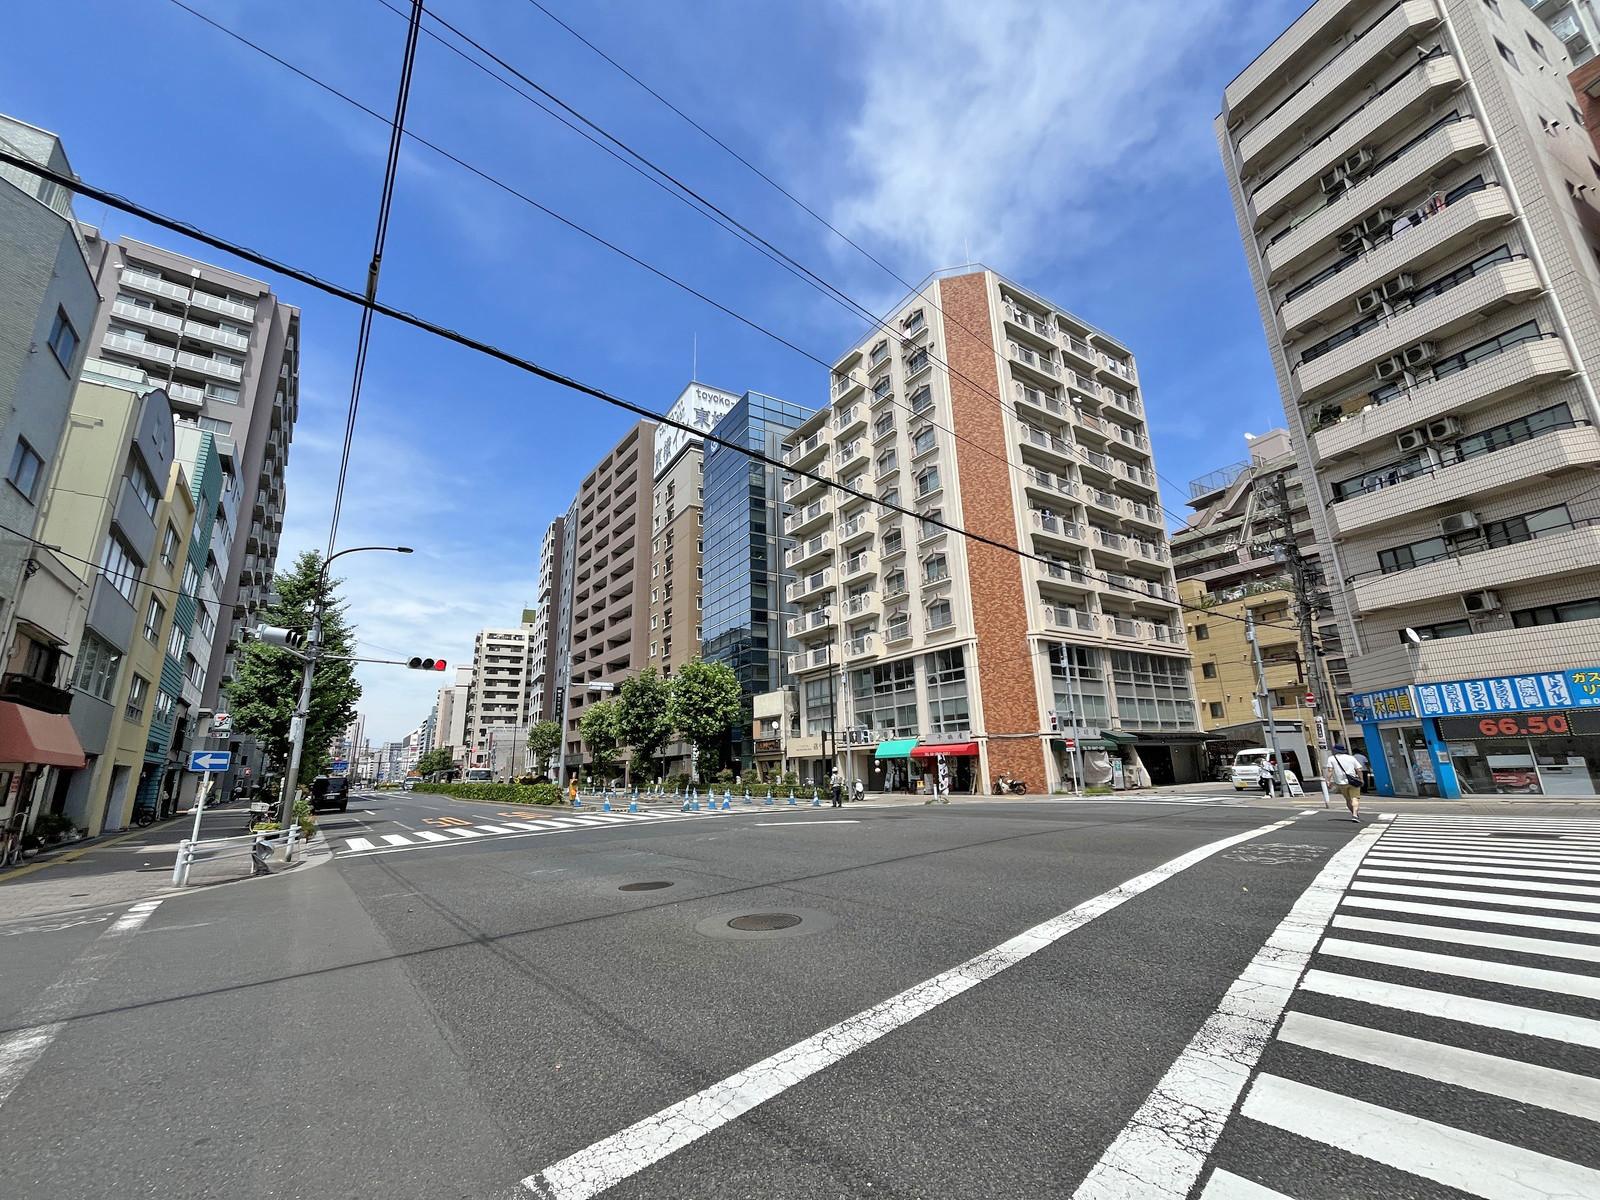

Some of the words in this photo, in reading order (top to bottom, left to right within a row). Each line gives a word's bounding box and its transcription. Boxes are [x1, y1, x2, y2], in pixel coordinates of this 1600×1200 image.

[1469, 682, 1488, 710] コンロ
[1548, 676, 1567, 704] トイレ
[1583, 684, 1600, 695] リ
[1373, 694, 1411, 715] 大問屋
[1479, 715, 1568, 736] 66.50
[422, 816, 474, 828] 50
